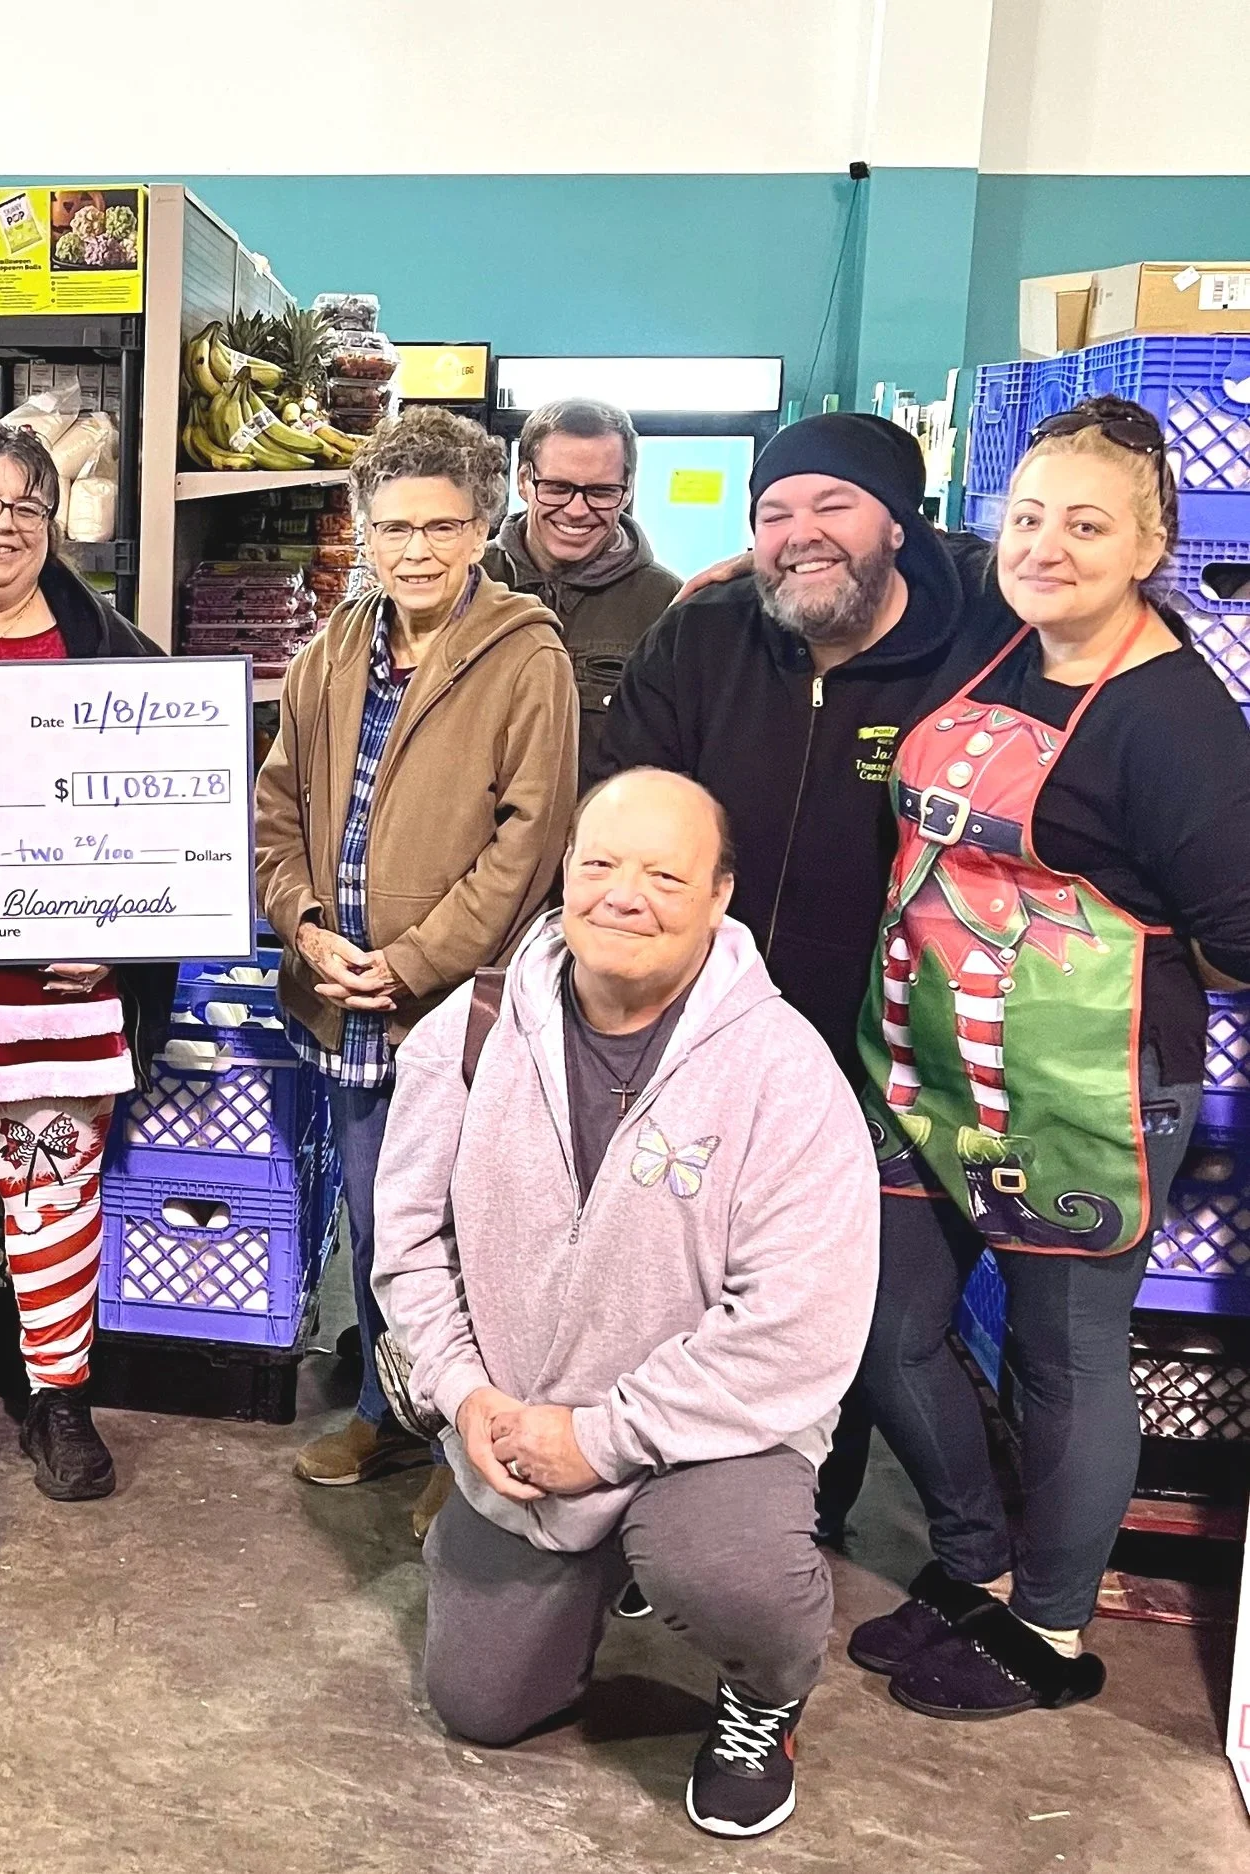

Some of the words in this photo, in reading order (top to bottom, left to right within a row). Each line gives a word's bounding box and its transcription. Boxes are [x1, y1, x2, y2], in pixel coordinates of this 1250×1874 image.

[6, 211, 25, 225] POP
[30, 716, 64, 728] Date
[74, 691, 220, 735] 12/8/2025
[54, 777, 69, 803] $
[86, 774, 226, 807] 11,082.28
[184, 850, 232, 862] Dollars
[2, 887, 177, 928] Bloomingfoods
